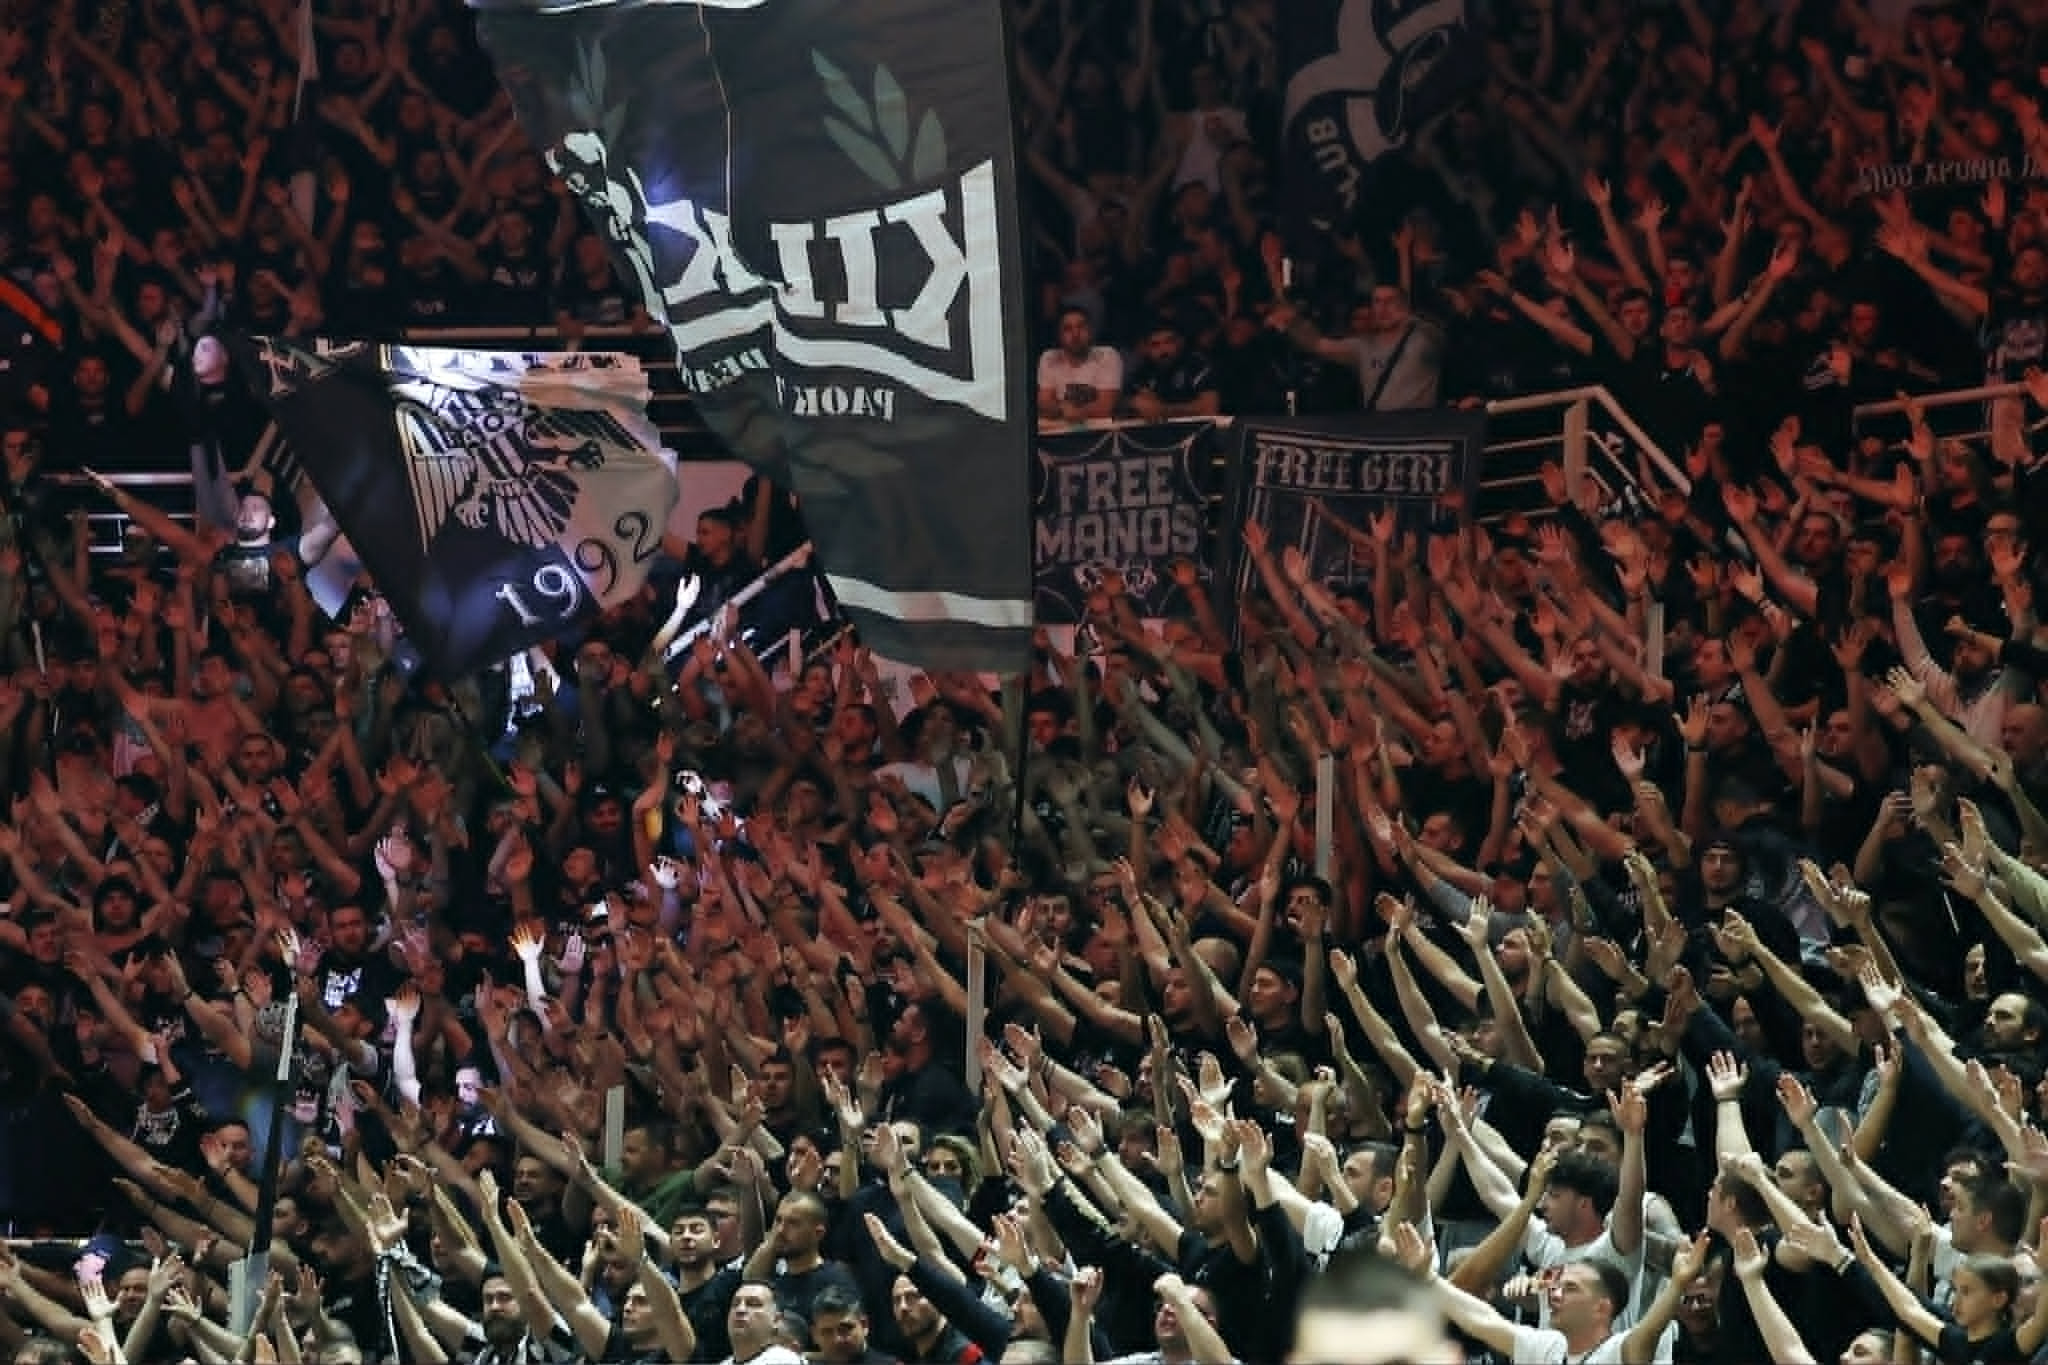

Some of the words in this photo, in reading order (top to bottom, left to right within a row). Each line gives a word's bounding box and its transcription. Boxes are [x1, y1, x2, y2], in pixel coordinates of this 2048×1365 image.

[1055, 454, 1175, 512] FREE
[1256, 441, 1354, 489] FREE
[1360, 451, 1452, 493] GERI
[1034, 503, 1199, 569] MANOS
[496, 511, 662, 626] 1992
